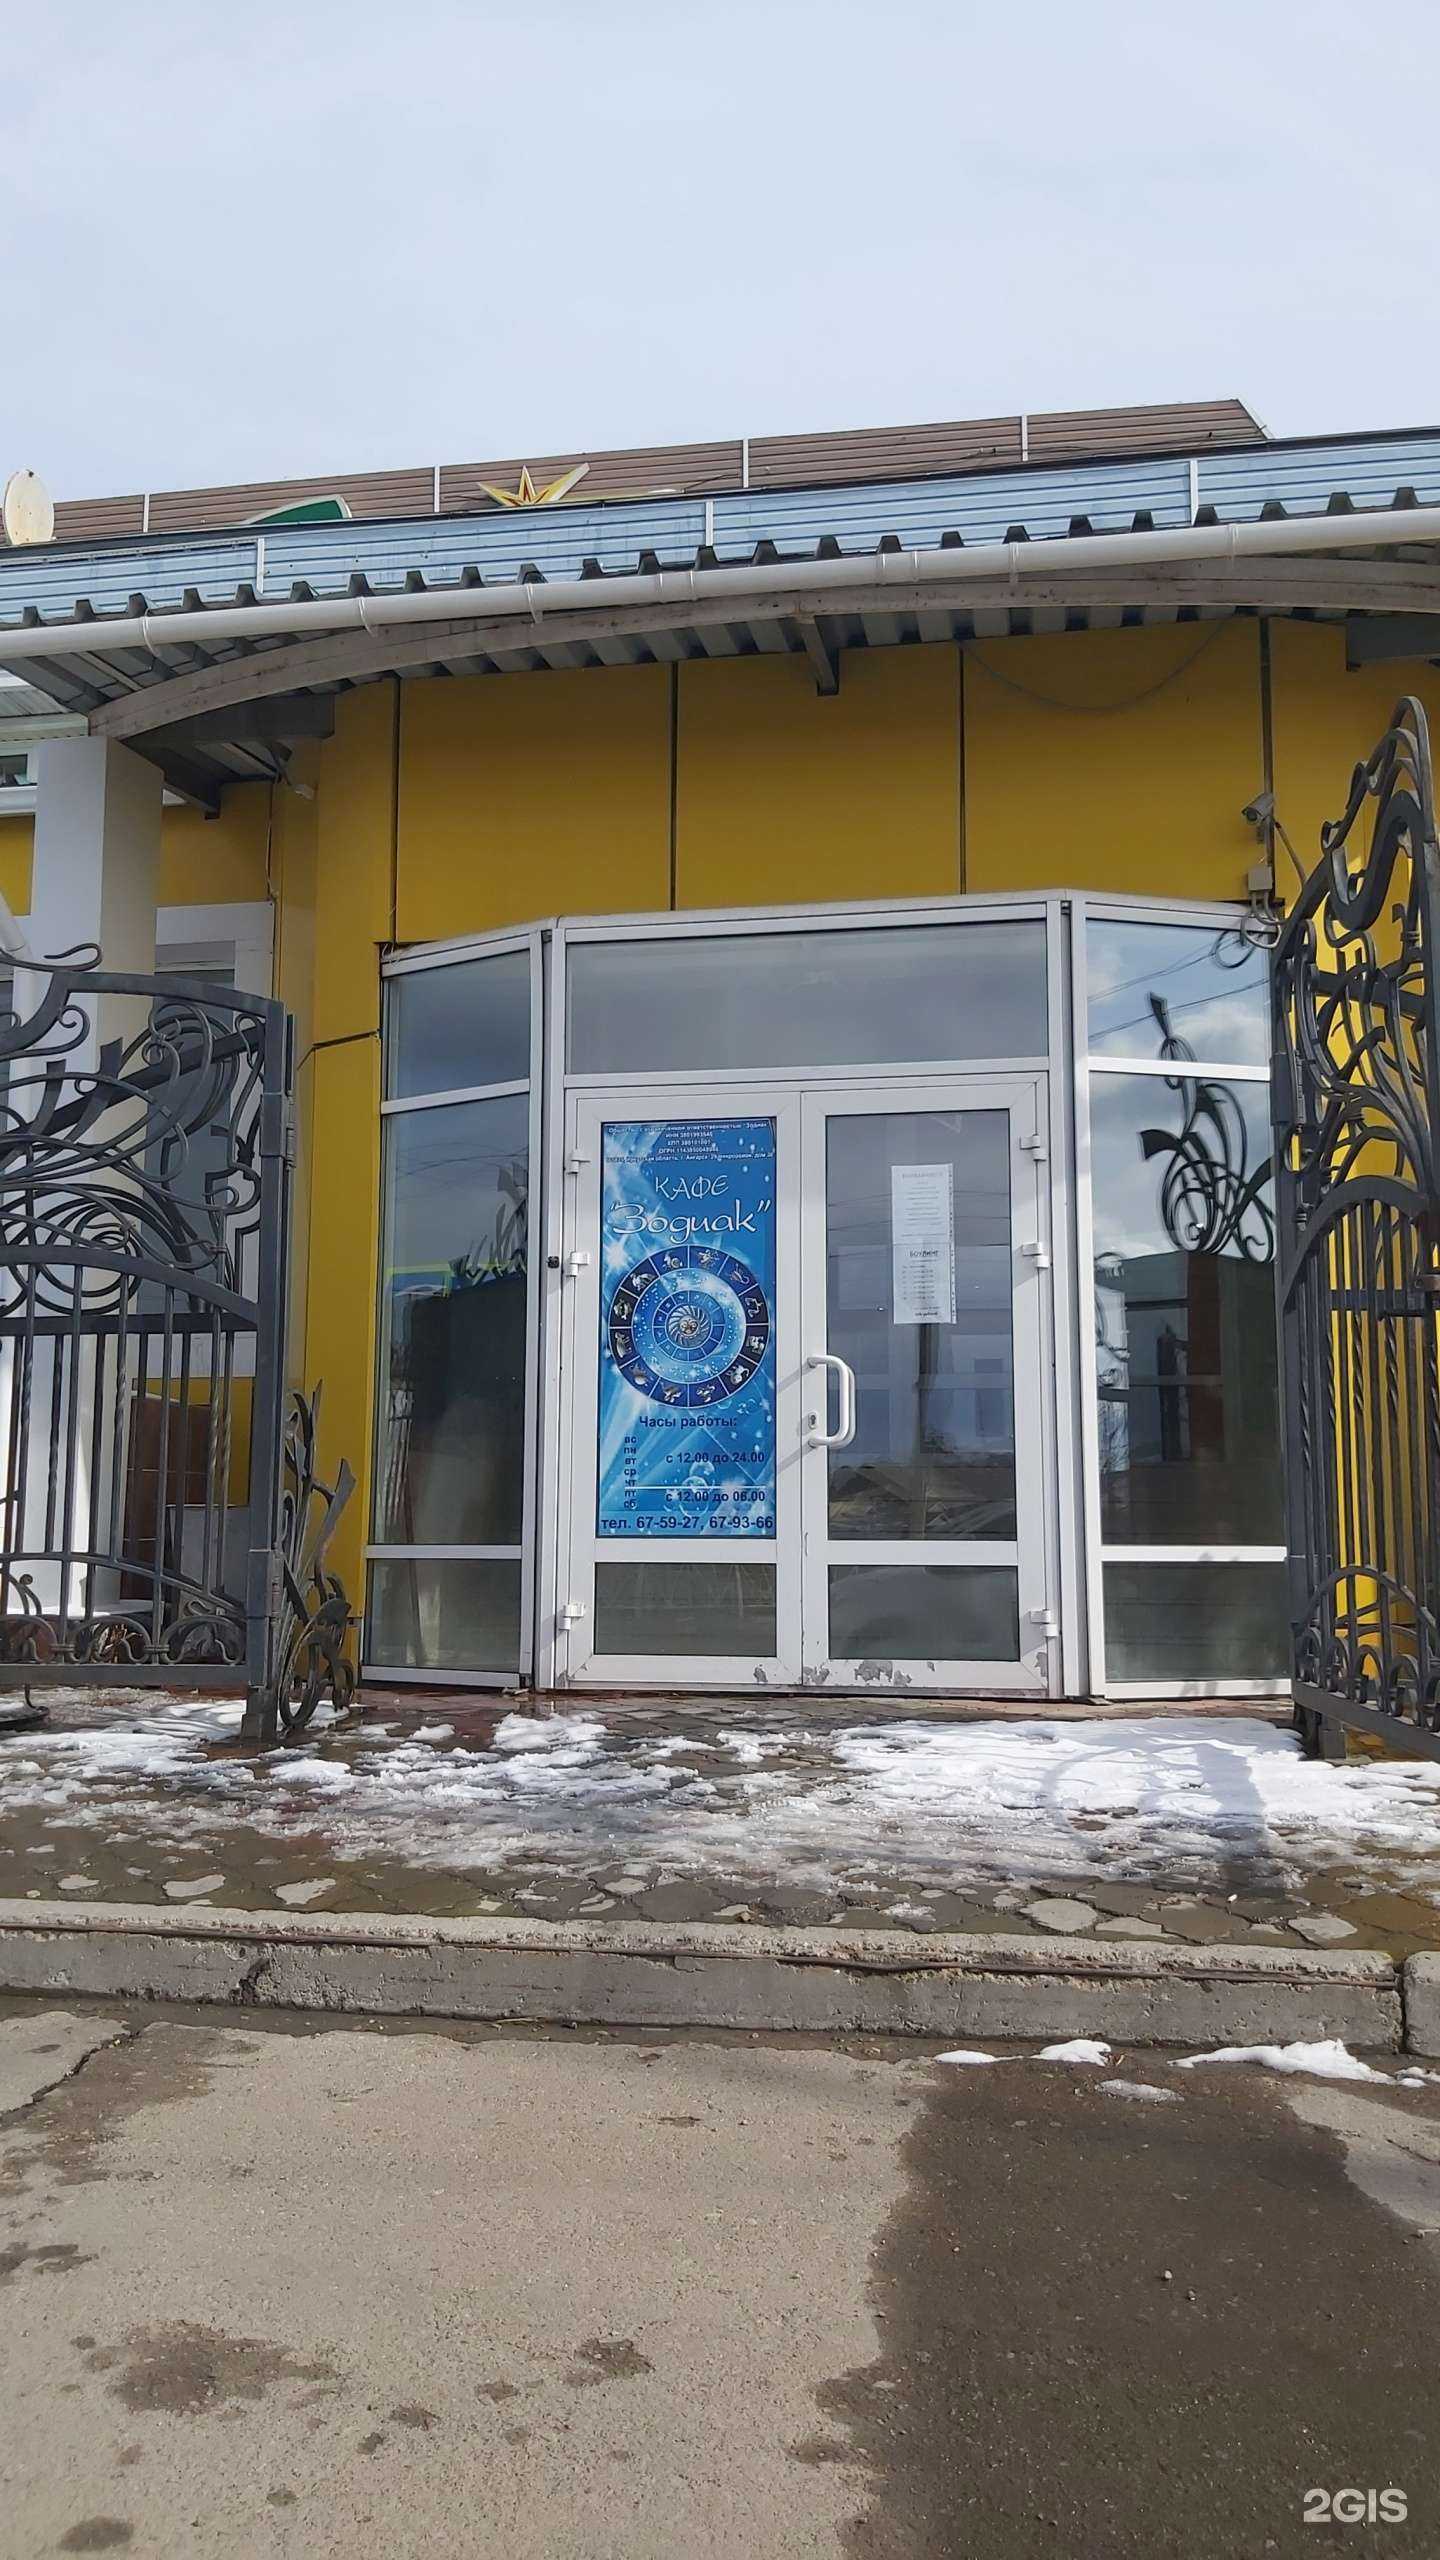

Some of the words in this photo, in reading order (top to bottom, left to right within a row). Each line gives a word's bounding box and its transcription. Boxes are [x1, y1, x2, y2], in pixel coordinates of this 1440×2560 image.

[655, 1174, 730, 1201] КАФЕ
[639, 1416, 676, 1427] Часы
[680, 1415, 737, 1429] работы:
[624, 1436, 637, 1444] вс
[624, 1446, 637, 1454] пн
[624, 1457, 637, 1465] вт
[666, 1455, 673, 1463] с
[678, 1452, 709, 1463] 12.00
[712, 1454, 729, 1464] до
[733, 1452, 765, 1463] 24.00
[624, 1468, 637, 1477] ср
[624, 1479, 637, 1487] чт
[666, 1494, 673, 1502] с
[678, 1491, 709, 1502] 12.00
[712, 1493, 729, 1503] до
[624, 1499, 637, 1509] сб
[601, 1518, 632, 1529] тел.
[636, 1516, 705, 1530] 67-59-27,
[709, 1516, 773, 1529] 67-93-66
